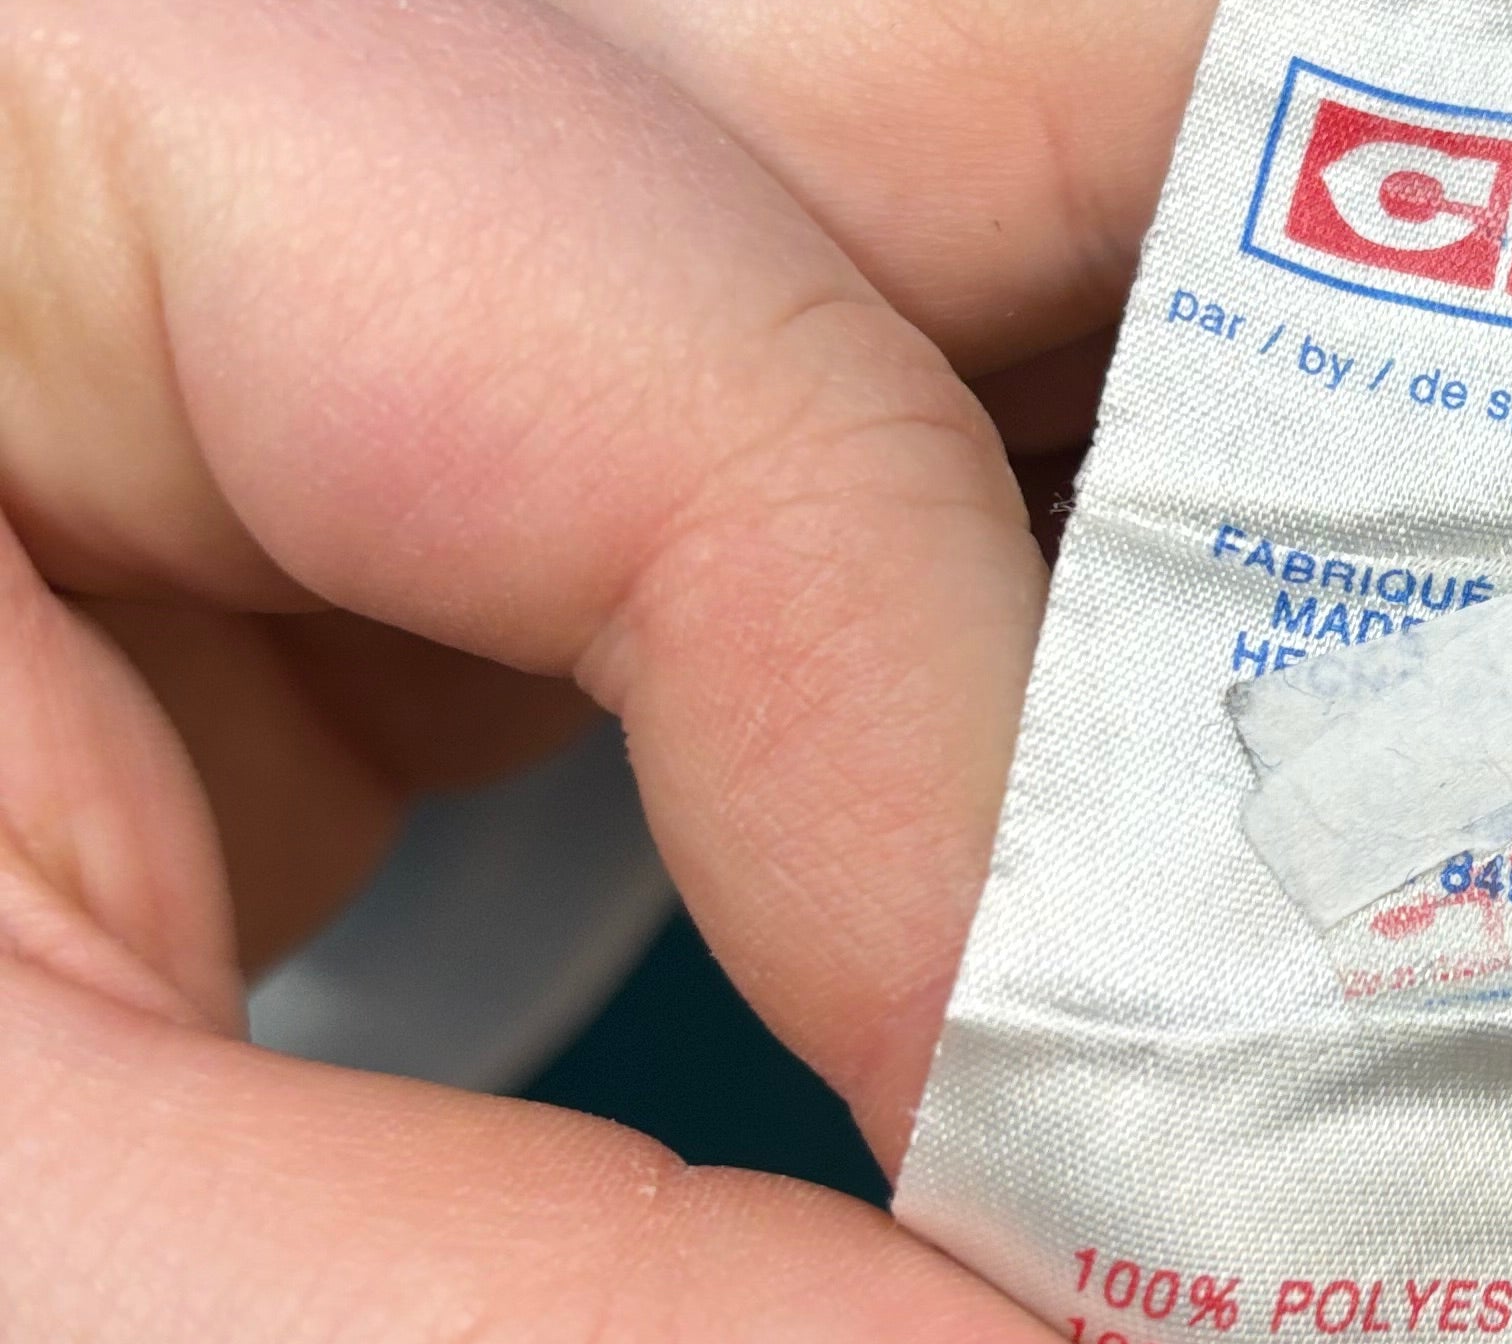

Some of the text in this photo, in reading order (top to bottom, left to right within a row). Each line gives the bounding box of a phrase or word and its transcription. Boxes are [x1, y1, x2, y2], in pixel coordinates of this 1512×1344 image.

[1167, 288, 1247, 341] par
[1298, 334, 1355, 391] by
[1408, 368, 1469, 410] de
[1073, 1247, 1242, 1333] 100%
